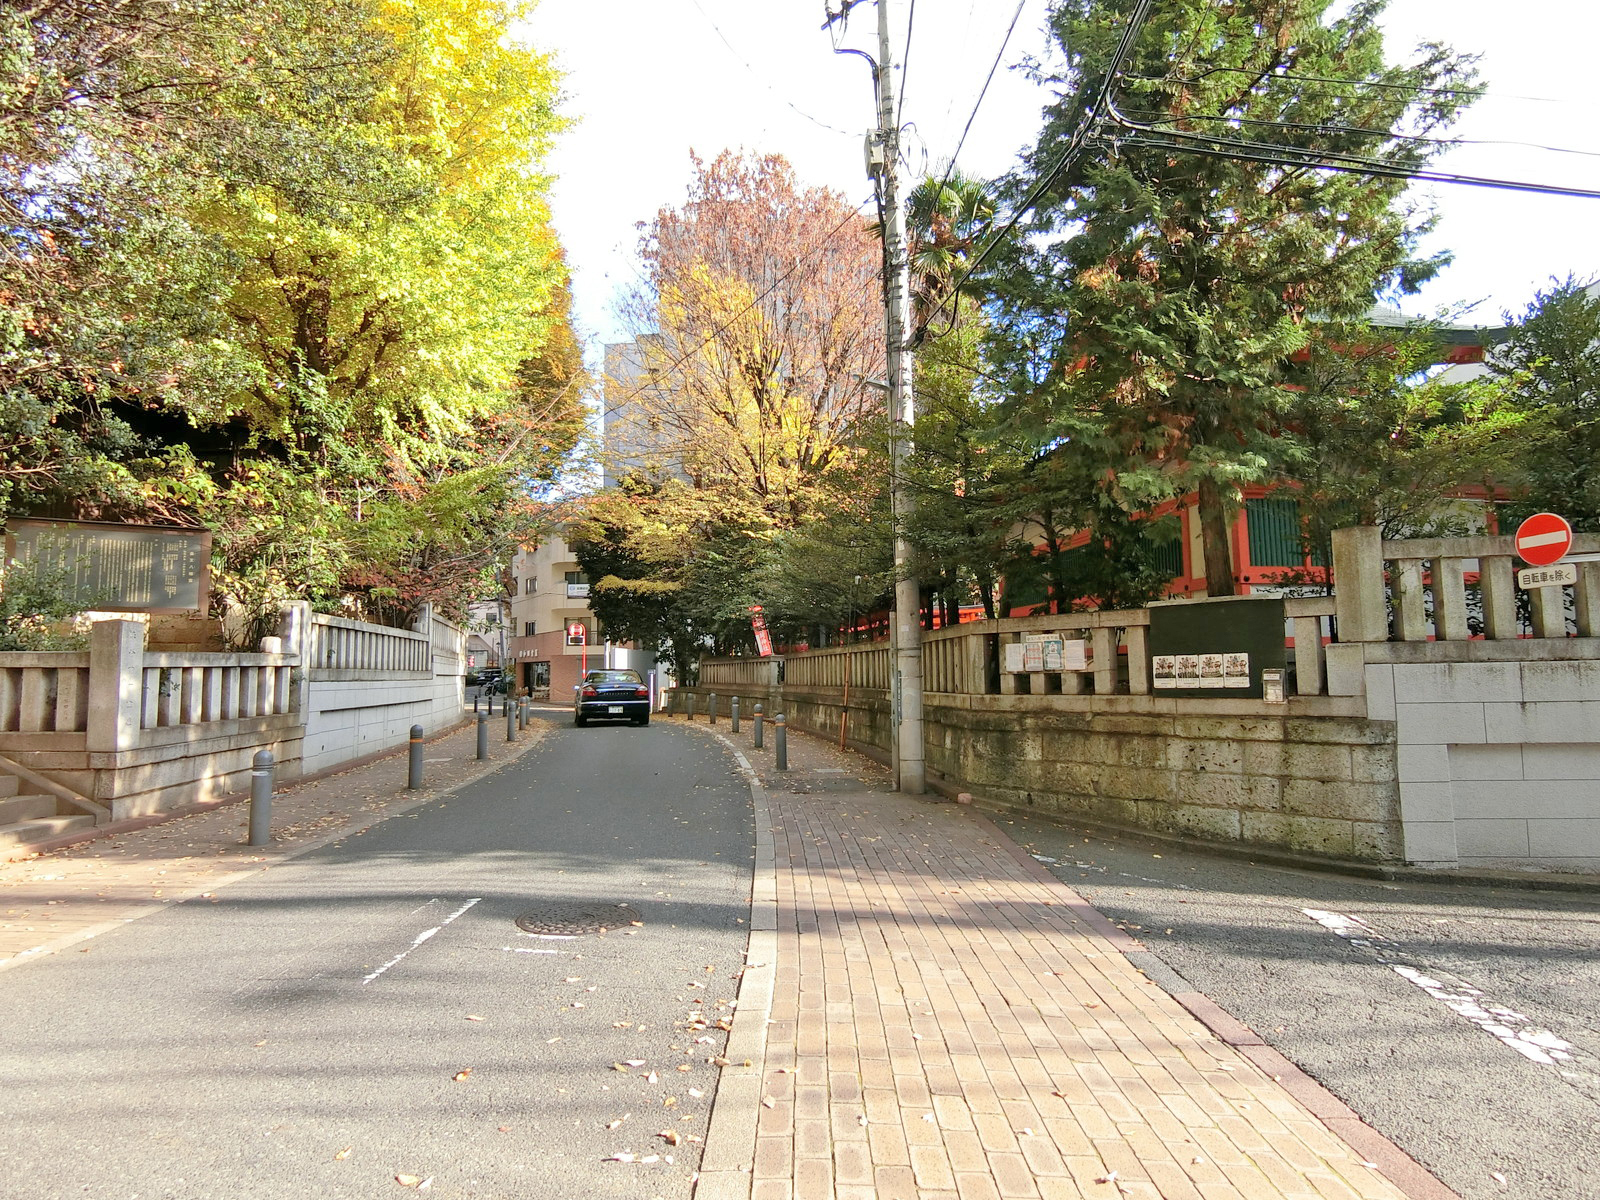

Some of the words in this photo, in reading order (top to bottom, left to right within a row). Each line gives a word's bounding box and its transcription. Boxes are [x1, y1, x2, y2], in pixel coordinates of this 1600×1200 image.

[1523, 569, 1571, 585] 自転車を除く
